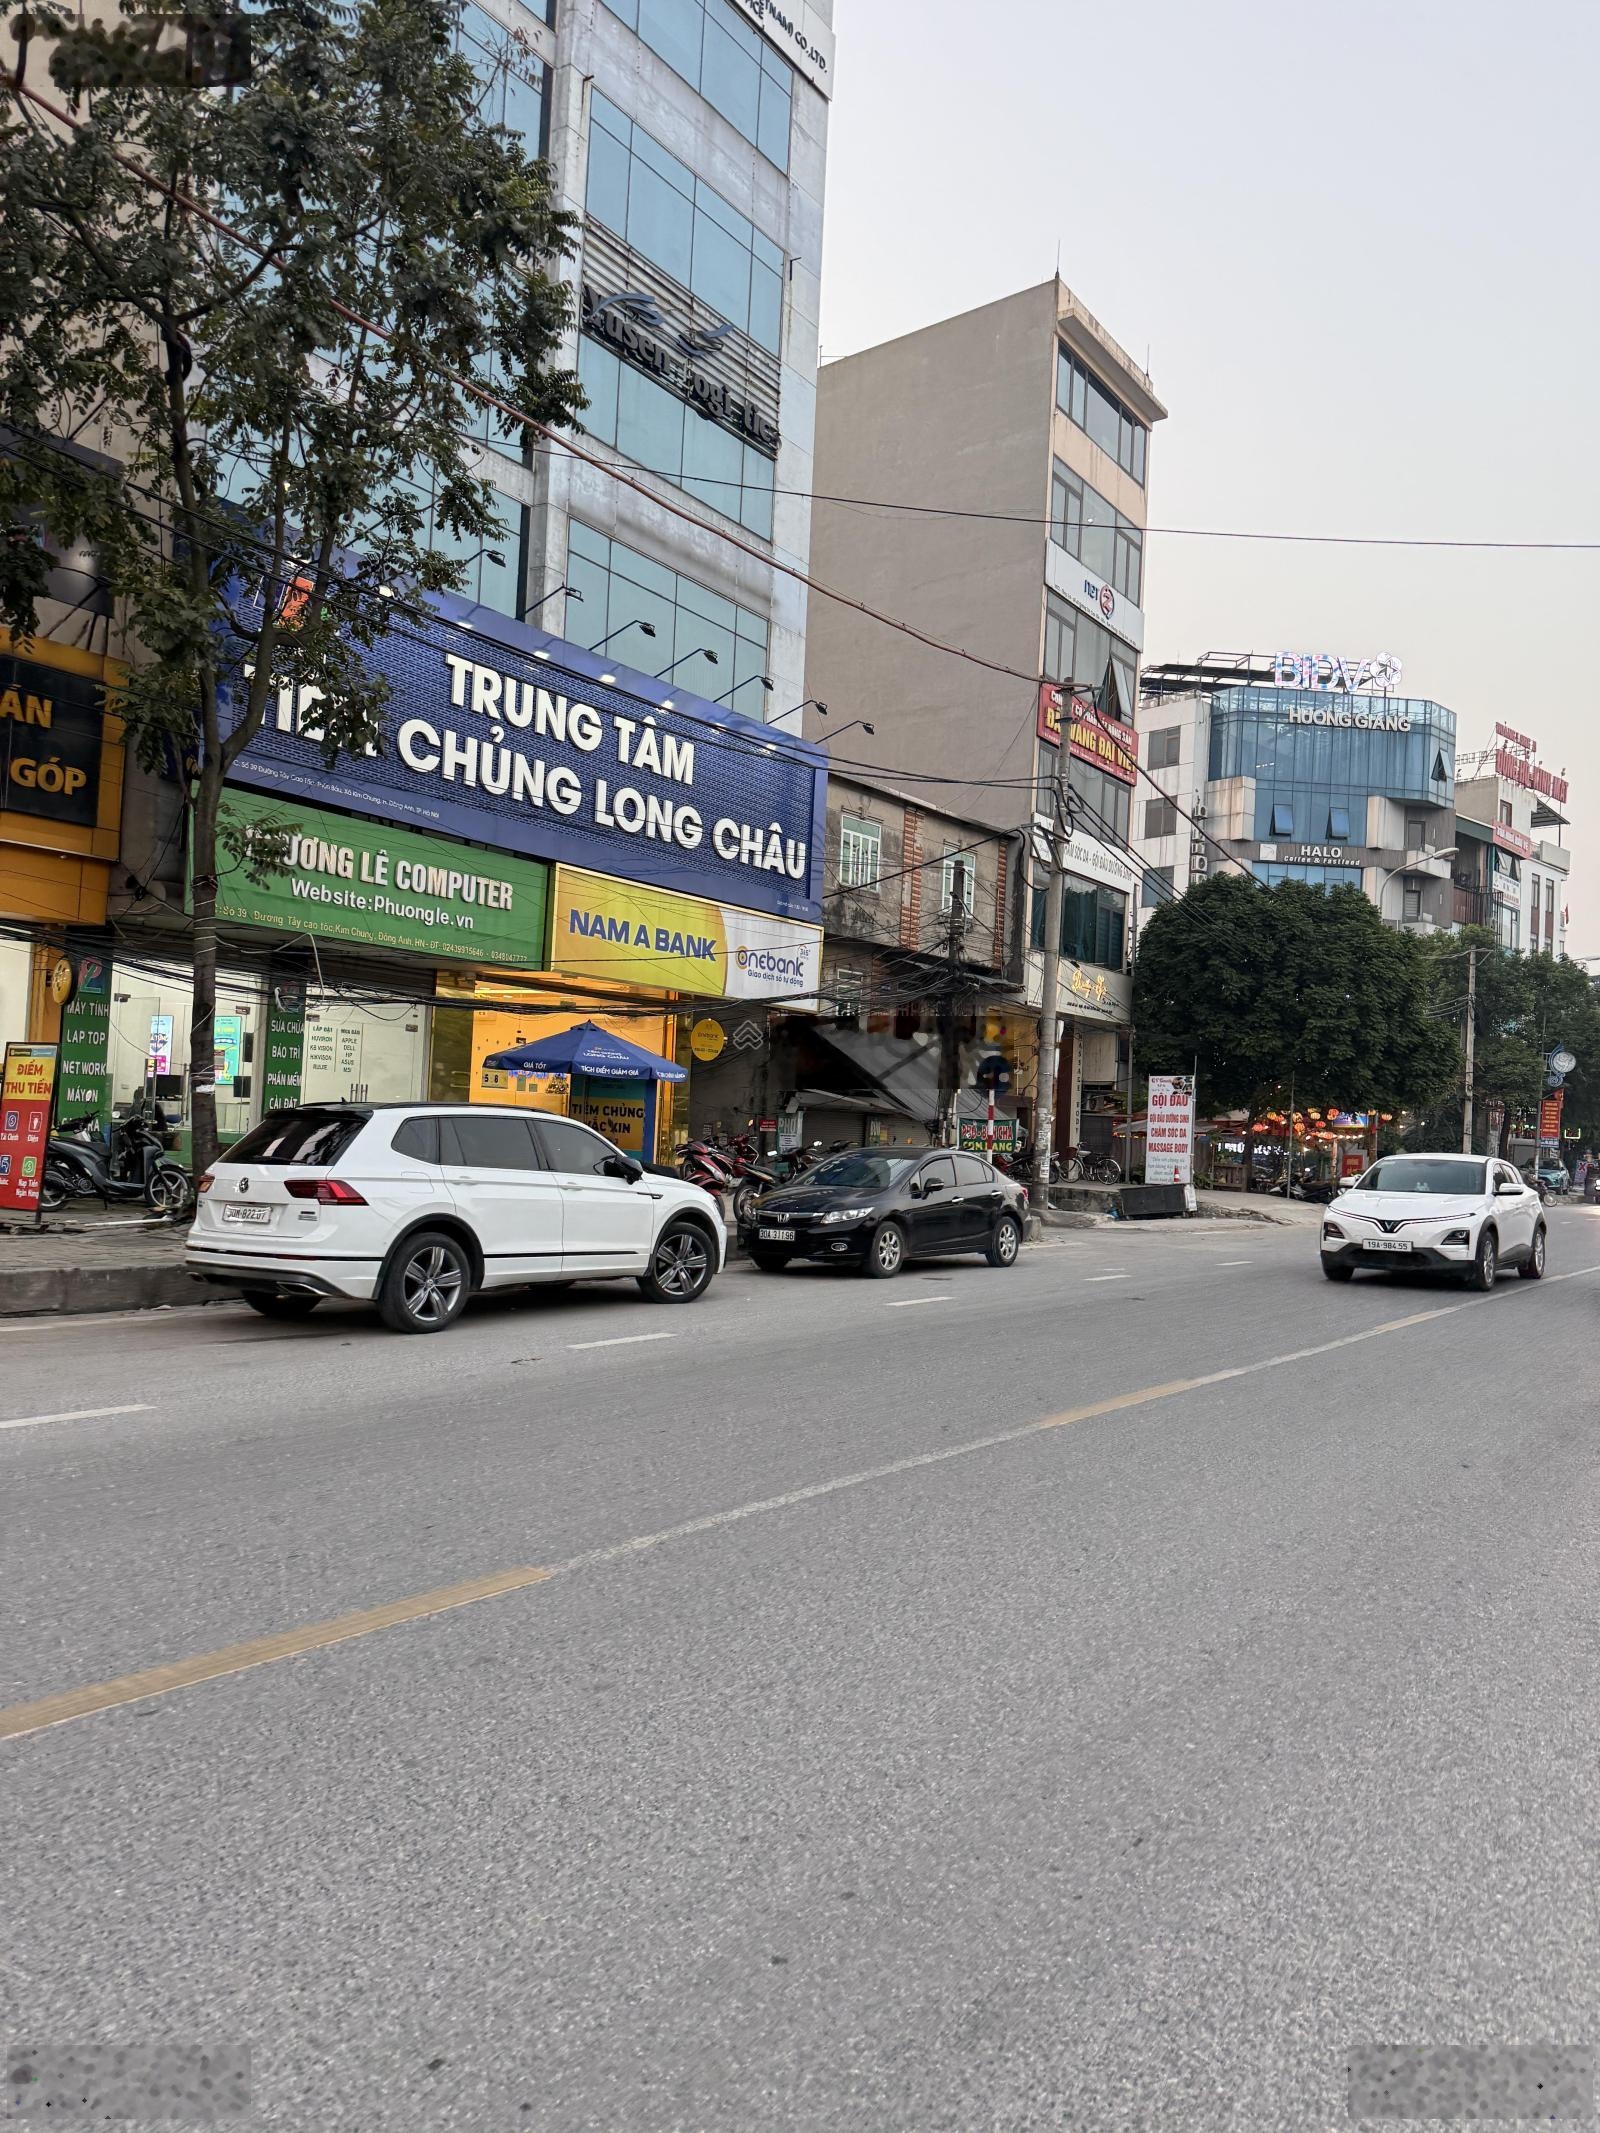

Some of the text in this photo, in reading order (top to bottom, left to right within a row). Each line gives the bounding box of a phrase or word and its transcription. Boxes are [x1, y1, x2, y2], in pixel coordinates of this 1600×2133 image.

[1275, 650, 1371, 693] BIDV
[445, 653, 695, 785] TRUNG TÂM
[1355, 713, 1411, 732] GIANG
[10, 757, 87, 795] GÓP
[397, 718, 582, 815] CHỦNG
[595, 779, 703, 850] LONG
[713, 821, 806, 880] CHÂU
[1301, 845, 1341, 858] HALO
[359, 849, 389, 886] LÊ
[395, 860, 513, 911] COMPUTER
[290, 877, 475, 930] Website:Phuongle.vn
[237, 908, 247, 918] 39
[303, 920, 318, 929] cao
[569, 909, 717, 962] NAM A BANK
[67, 996, 110, 1017] MÁY TÍNH
[67, 1029, 106, 1045] LAP TOP
[62, 1060, 107, 1076] NET WORK
[6, 1081, 26, 1095] THU
[602, 1102, 644, 1119] CHỦNG
[1152, 1092, 1167, 1109] GỘI
[1148, 1142, 1188, 1153] MASSAGE BODY
